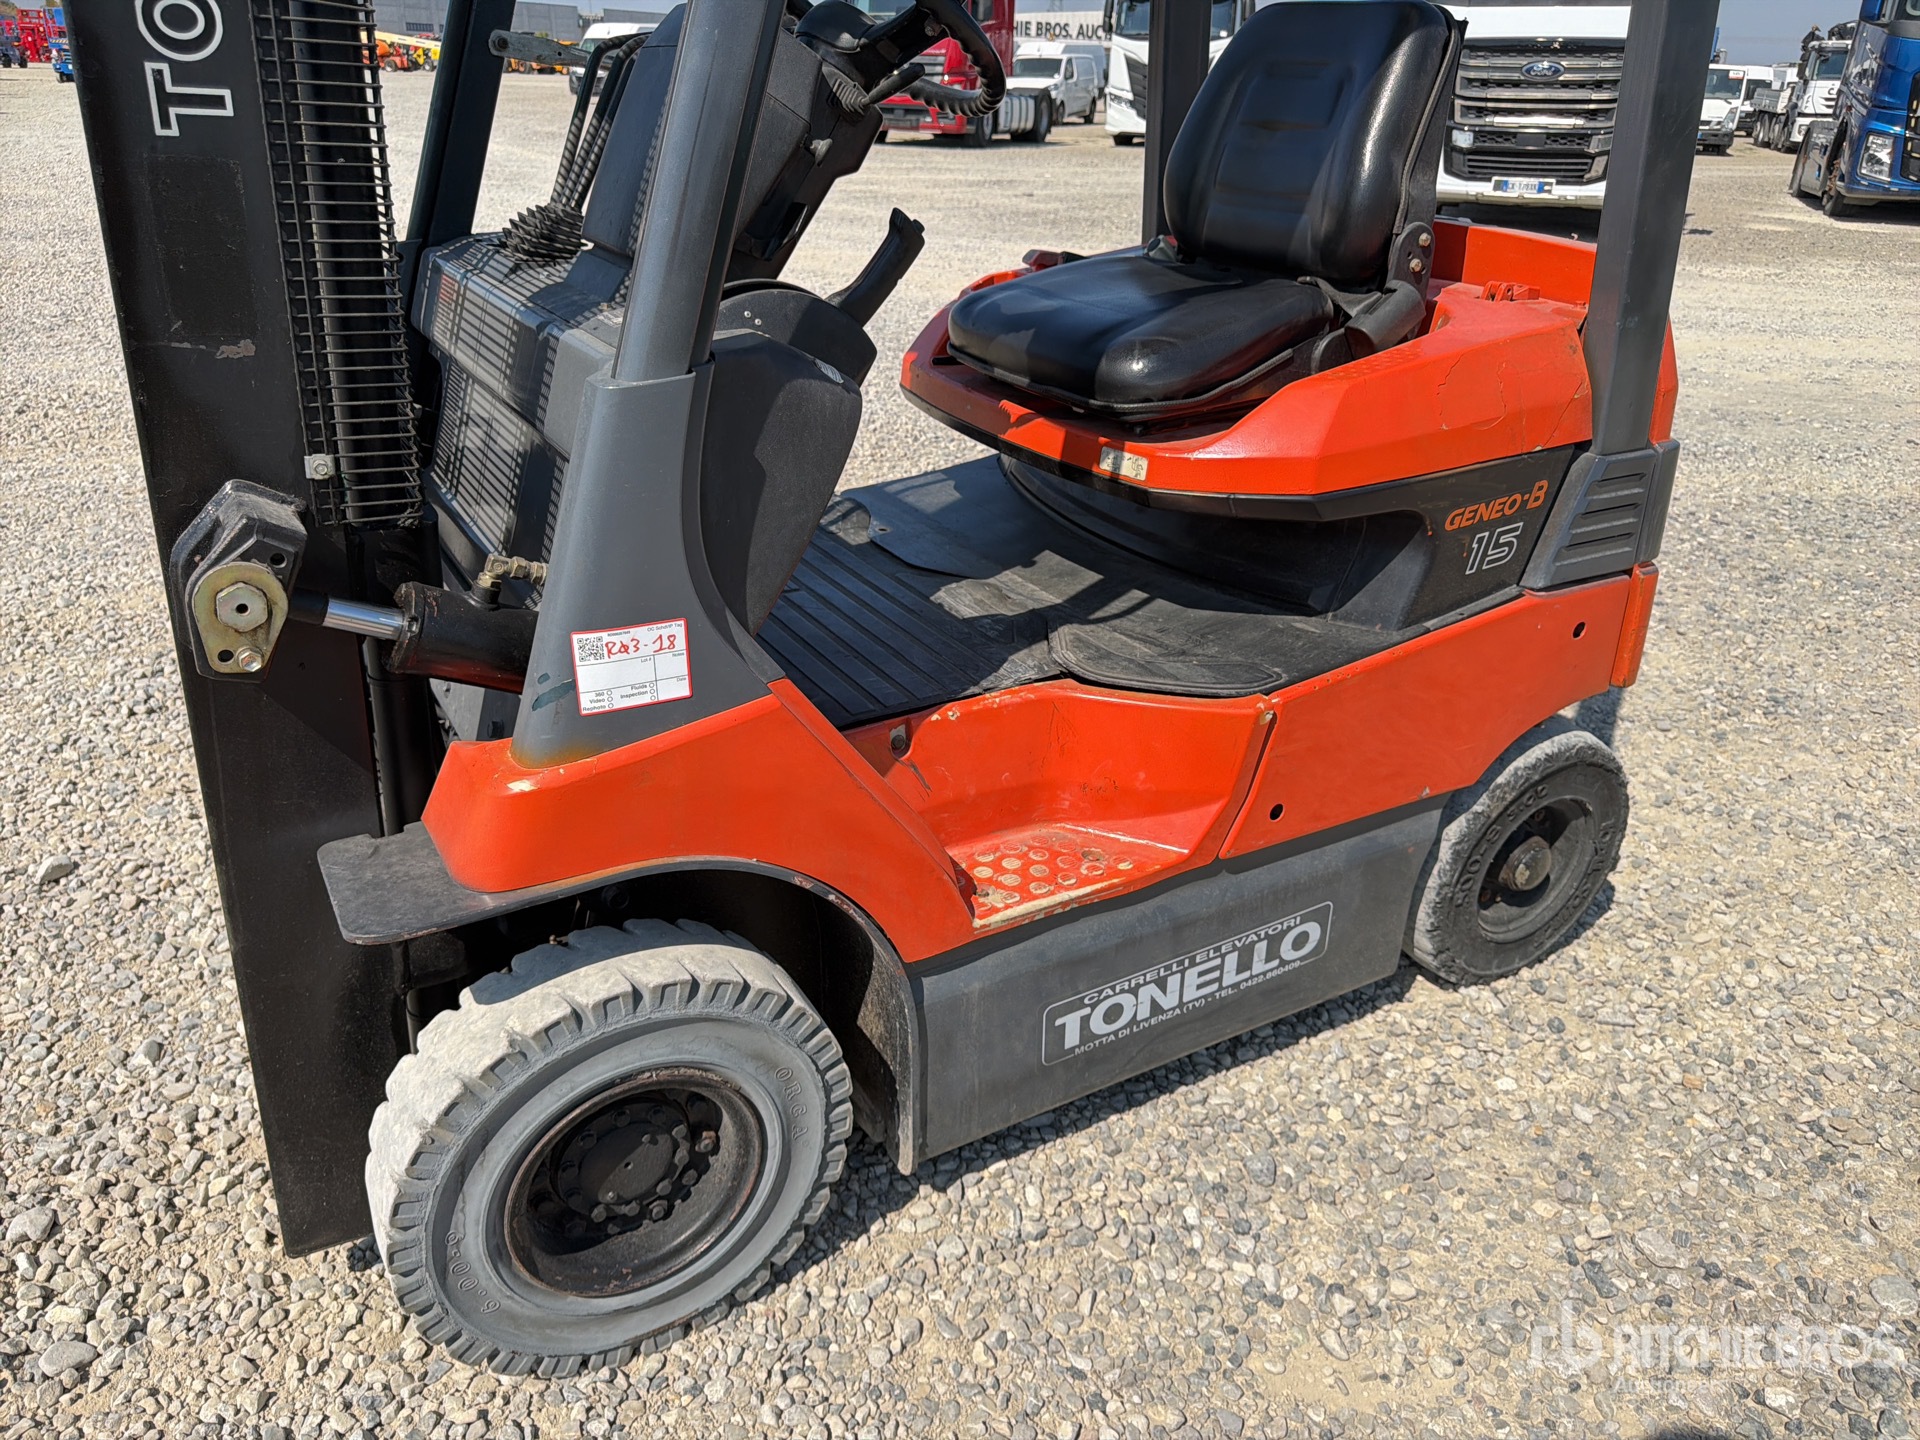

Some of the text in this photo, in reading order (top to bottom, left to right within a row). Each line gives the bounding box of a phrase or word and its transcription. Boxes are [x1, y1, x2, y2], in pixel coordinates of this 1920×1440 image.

[1036, 22, 1073, 38] BROS.
[135, 0, 234, 136] TO
[1444, 479, 1549, 532] GENEO-B
[1465, 521, 1524, 575] 15
[582, 704, 606, 712] Rephoto
[620, 690, 648, 700] Inspection
[1054, 921, 1322, 1050] TONELLO
[1083, 916, 1301, 1005] CARRELLI ELEVATORI
[1074, 1034, 1116, 1056] MOTTA
[1118, 1028, 1130, 1039] DI
[1133, 1008, 1182, 1033] LIVENZA
[1183, 998, 1206, 1014] (TV)
[1214, 987, 1238, 1000] TEL.
